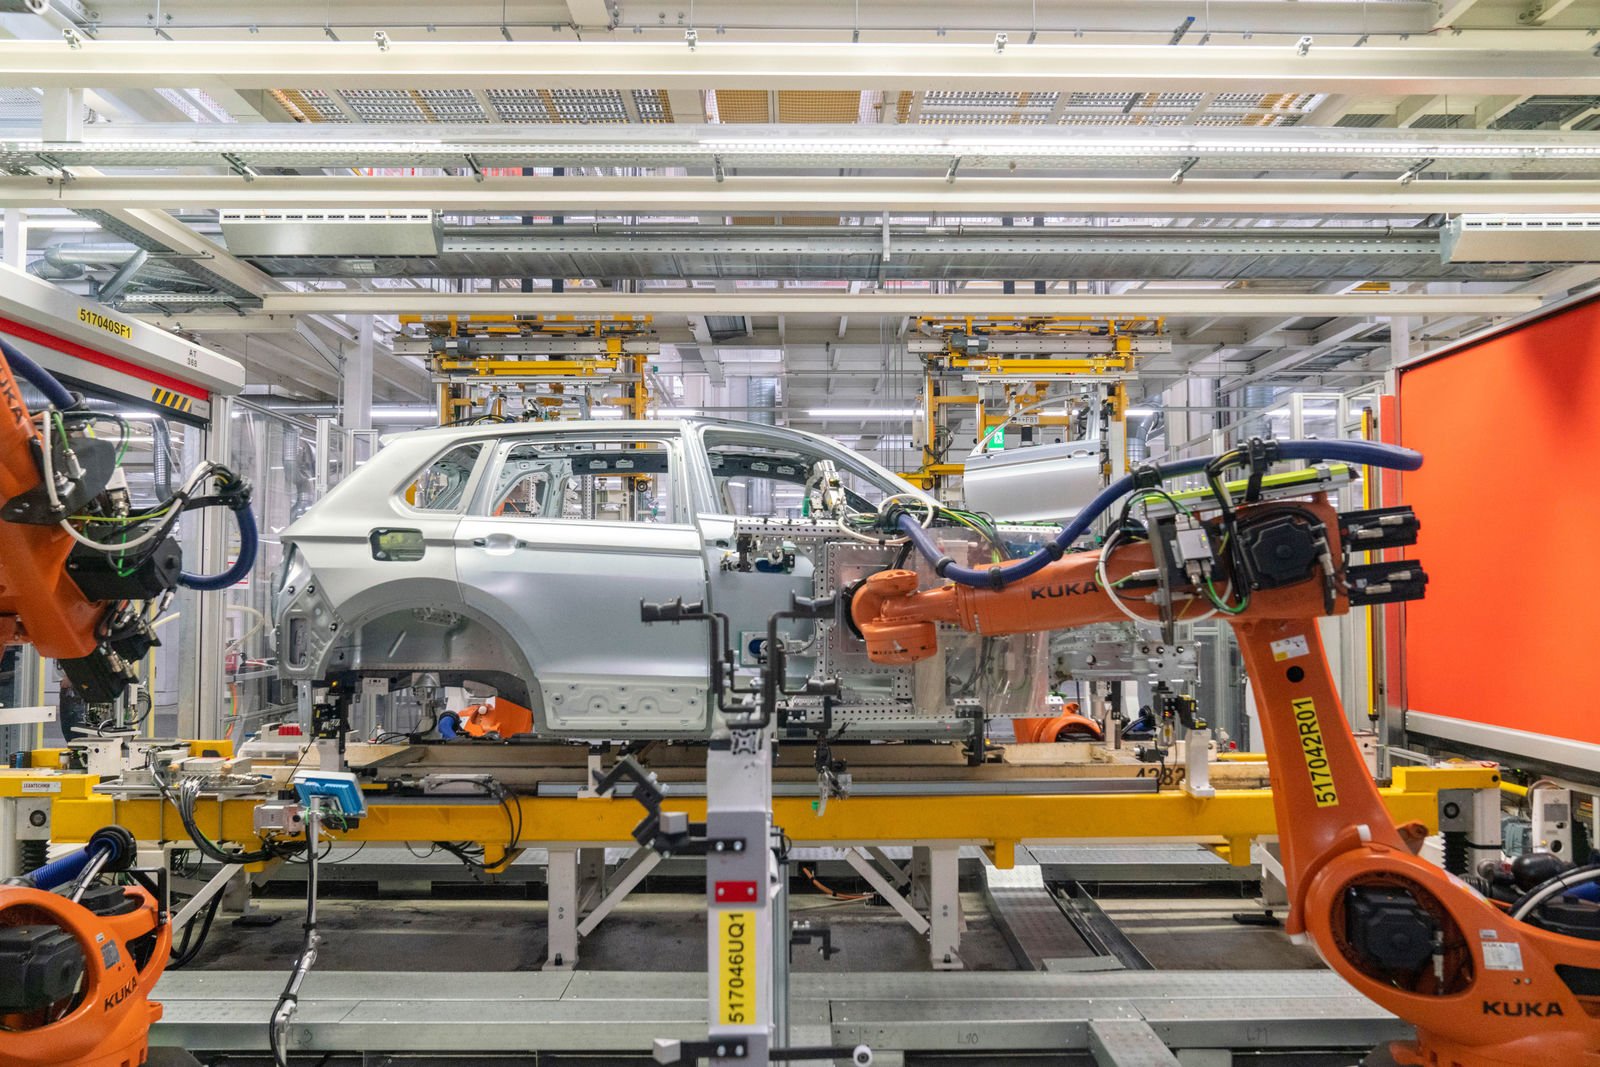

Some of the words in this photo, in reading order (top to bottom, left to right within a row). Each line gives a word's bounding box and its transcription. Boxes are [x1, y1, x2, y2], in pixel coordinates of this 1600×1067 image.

[80, 308, 131, 339] 517040SF1
[1031, 581, 1099, 600] KUKA
[1293, 700, 1336, 803] 517042R01
[728, 913, 745, 1023] 517046UQ1
[104, 976, 137, 1011] KUKA
[1483, 1001, 1564, 1017] KUKA
